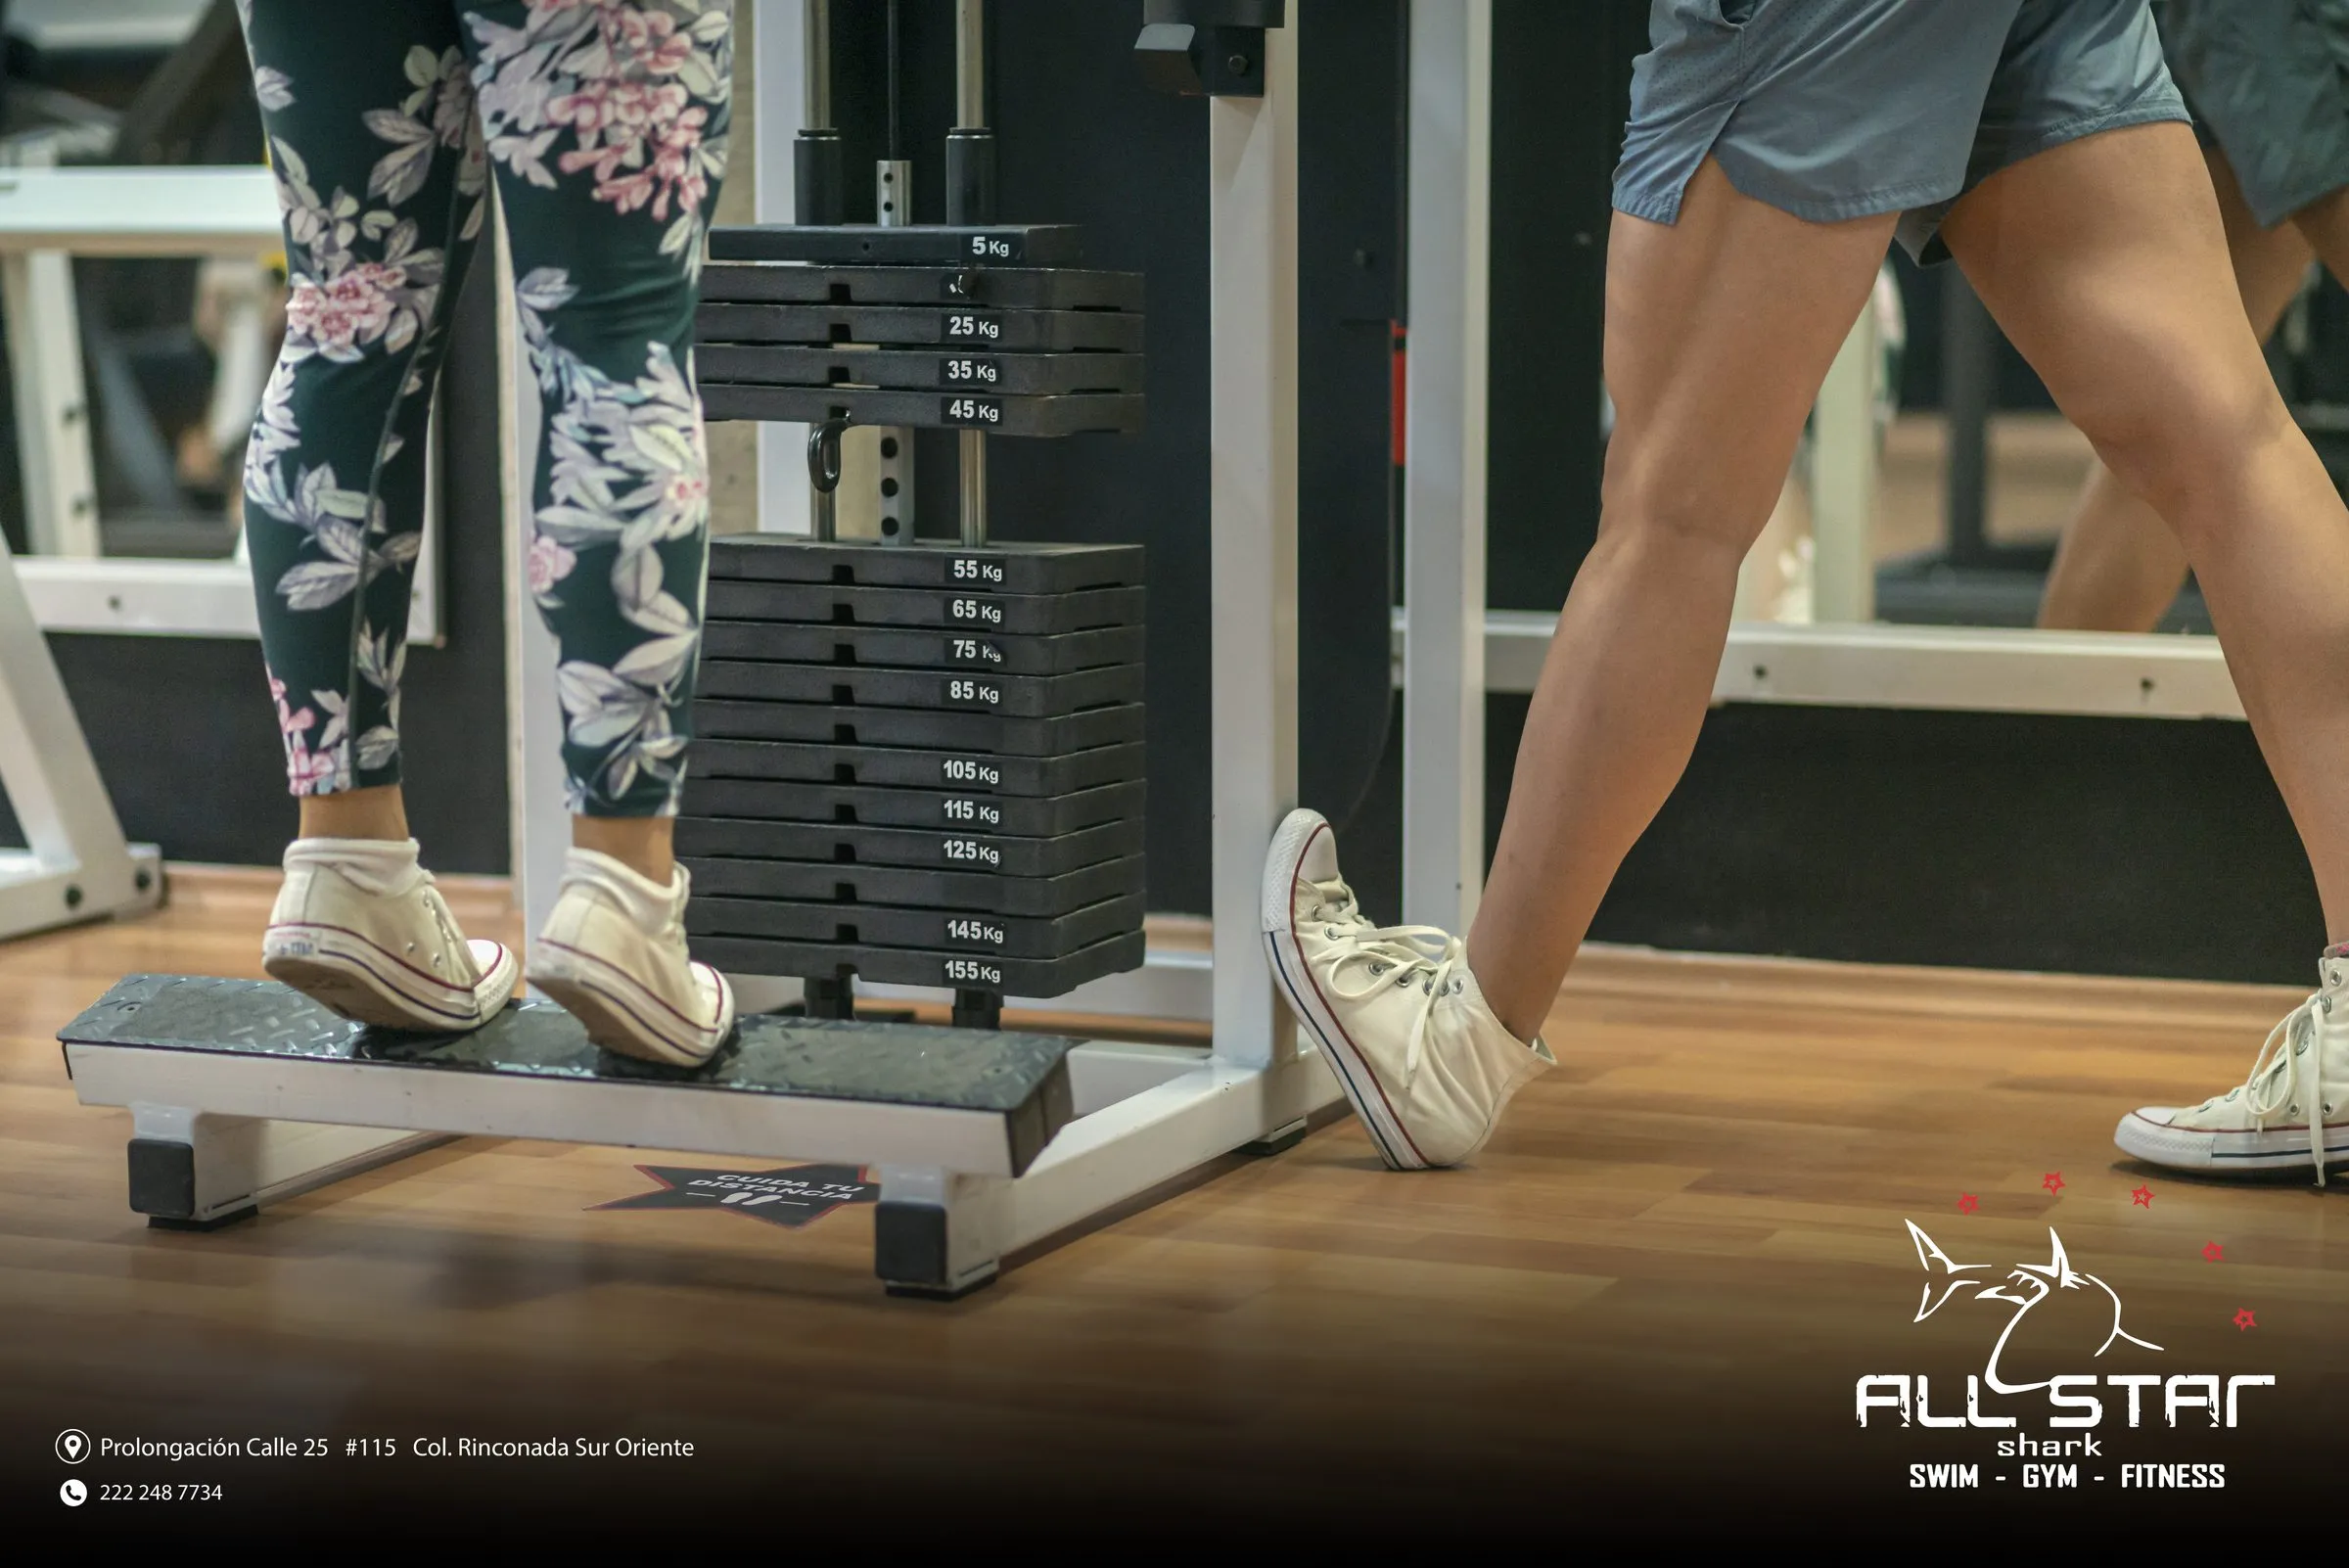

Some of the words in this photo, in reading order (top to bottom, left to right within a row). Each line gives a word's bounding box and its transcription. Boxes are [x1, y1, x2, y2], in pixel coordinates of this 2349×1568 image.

[972, 236, 986, 255] 5
[989, 240, 1009, 256] Kg
[949, 315, 974, 336] 25
[979, 321, 999, 339] Kg
[947, 360, 973, 380] 35
[977, 364, 996, 382] Kg
[949, 399, 975, 419] 45
[979, 405, 998, 422] Kg
[953, 559, 978, 578] 55
[982, 565, 1002, 581] Kg
[952, 599, 977, 619] 65
[982, 605, 1001, 623] Kg
[953, 639, 977, 659] 75
[950, 680, 975, 700] 85
[979, 686, 999, 704] Kg
[943, 760, 977, 780] 105
[979, 766, 999, 784] Kg
[944, 799, 974, 820] 115
[979, 806, 999, 824] Kg
[943, 839, 977, 860] 125
[979, 846, 999, 864] Kg
[947, 919, 982, 940] 145
[984, 926, 1004, 944] Kg
[944, 959, 979, 980] 155
[981, 966, 1001, 984] Kg
[687, 1179, 853, 1200] DISTANCIA
[716, 1175, 810, 1188] CUIDA
[821, 1183, 865, 1192] TU
